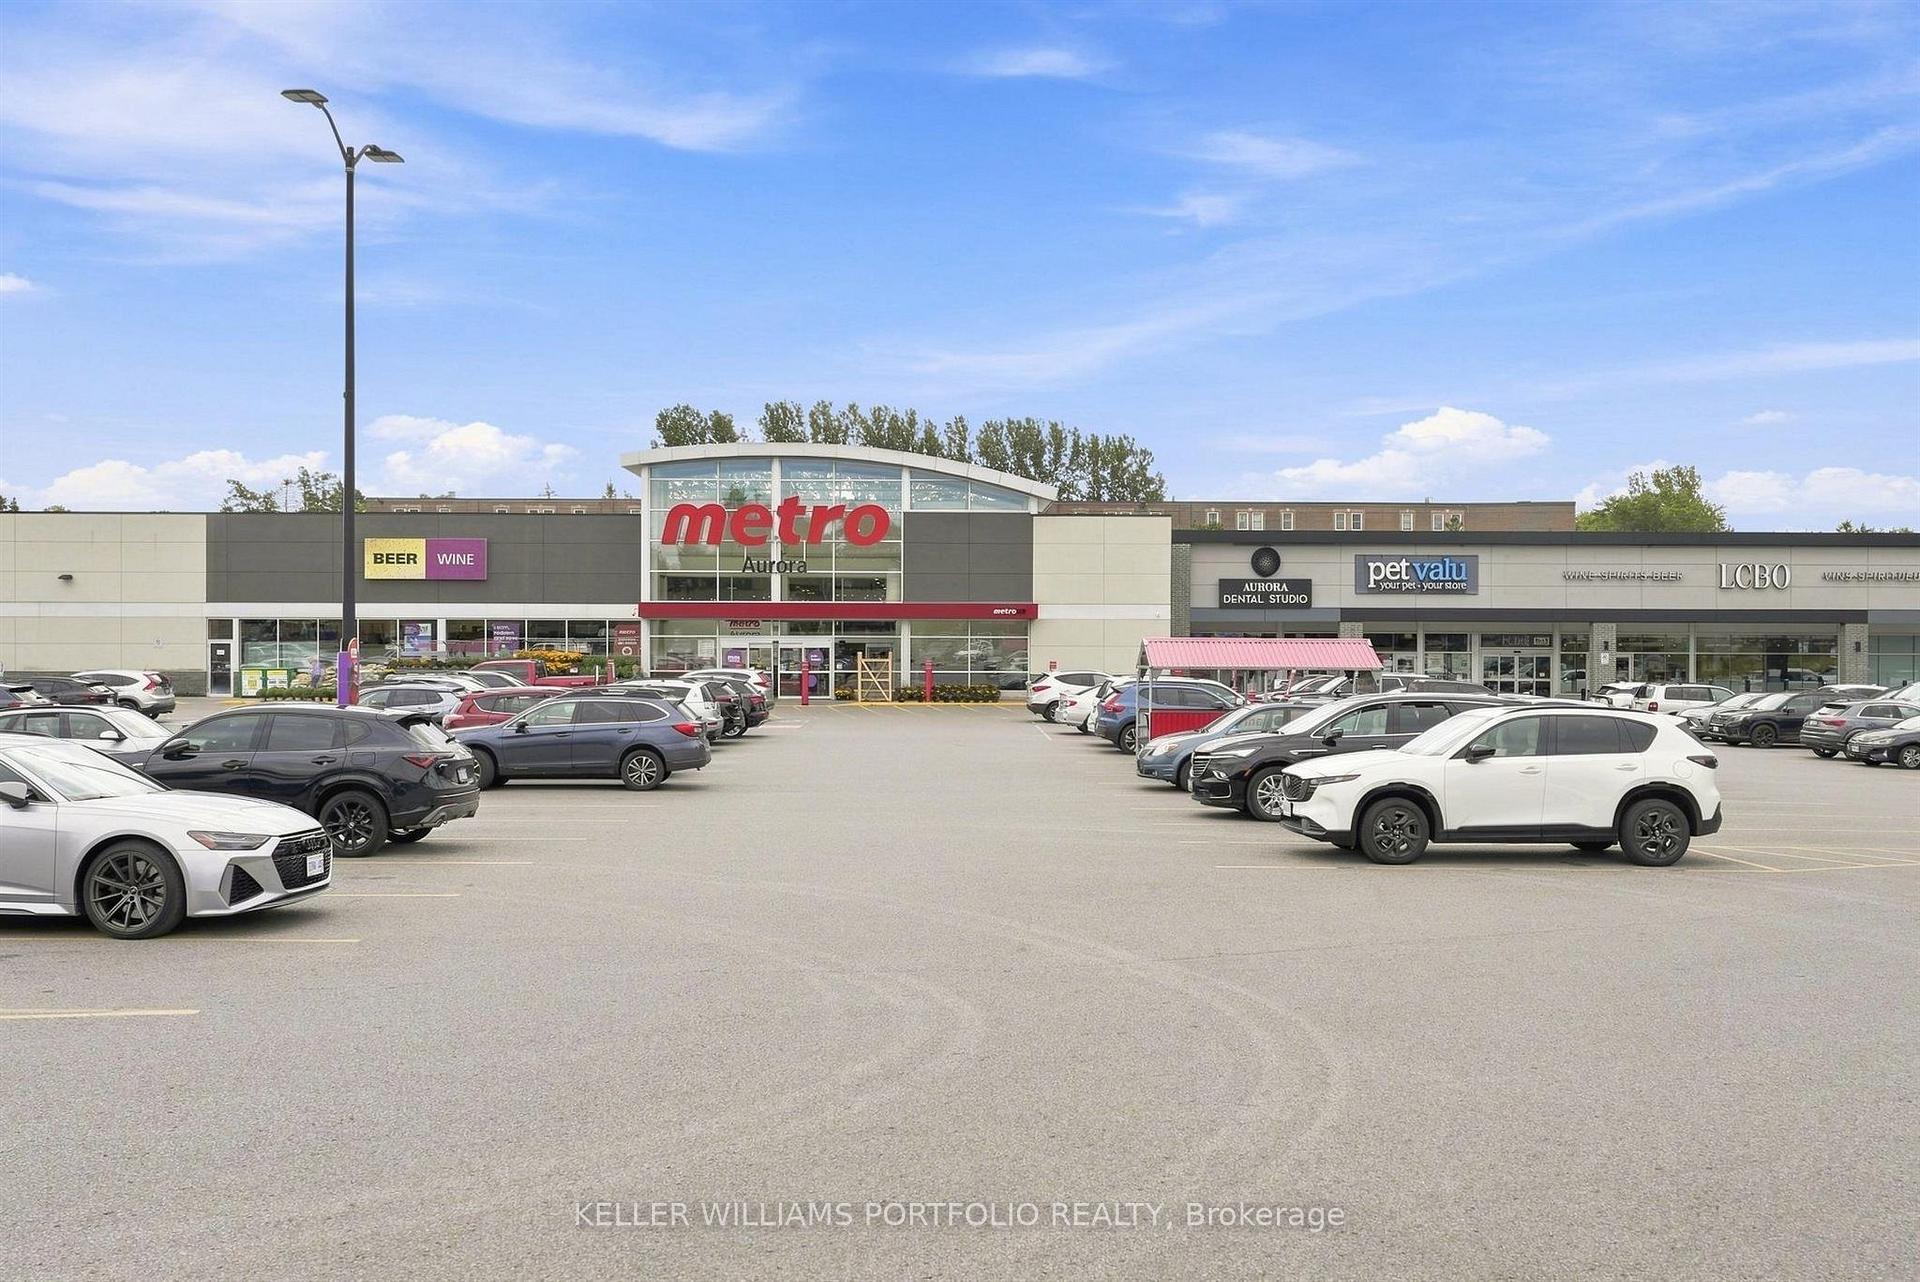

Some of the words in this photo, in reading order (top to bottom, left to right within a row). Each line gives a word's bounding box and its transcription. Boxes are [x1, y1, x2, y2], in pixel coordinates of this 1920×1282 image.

[661, 495, 891, 546] metro
[373, 553, 417, 565] BEER
[437, 553, 475, 565] WINE
[742, 556, 808, 574] Aurora
[1367, 558, 1410, 588] pet
[1412, 557, 1468, 580] valu
[1719, 563, 1791, 589] LCBO
[1243, 582, 1289, 592] AURORA
[1379, 581, 1400, 591] your
[1402, 580, 1417, 591] pet
[1422, 581, 1443, 592] your
[1445, 580, 1468, 590] store
[1223, 594, 1265, 604] DENTAL
[1269, 594, 1308, 604] STUDIO
